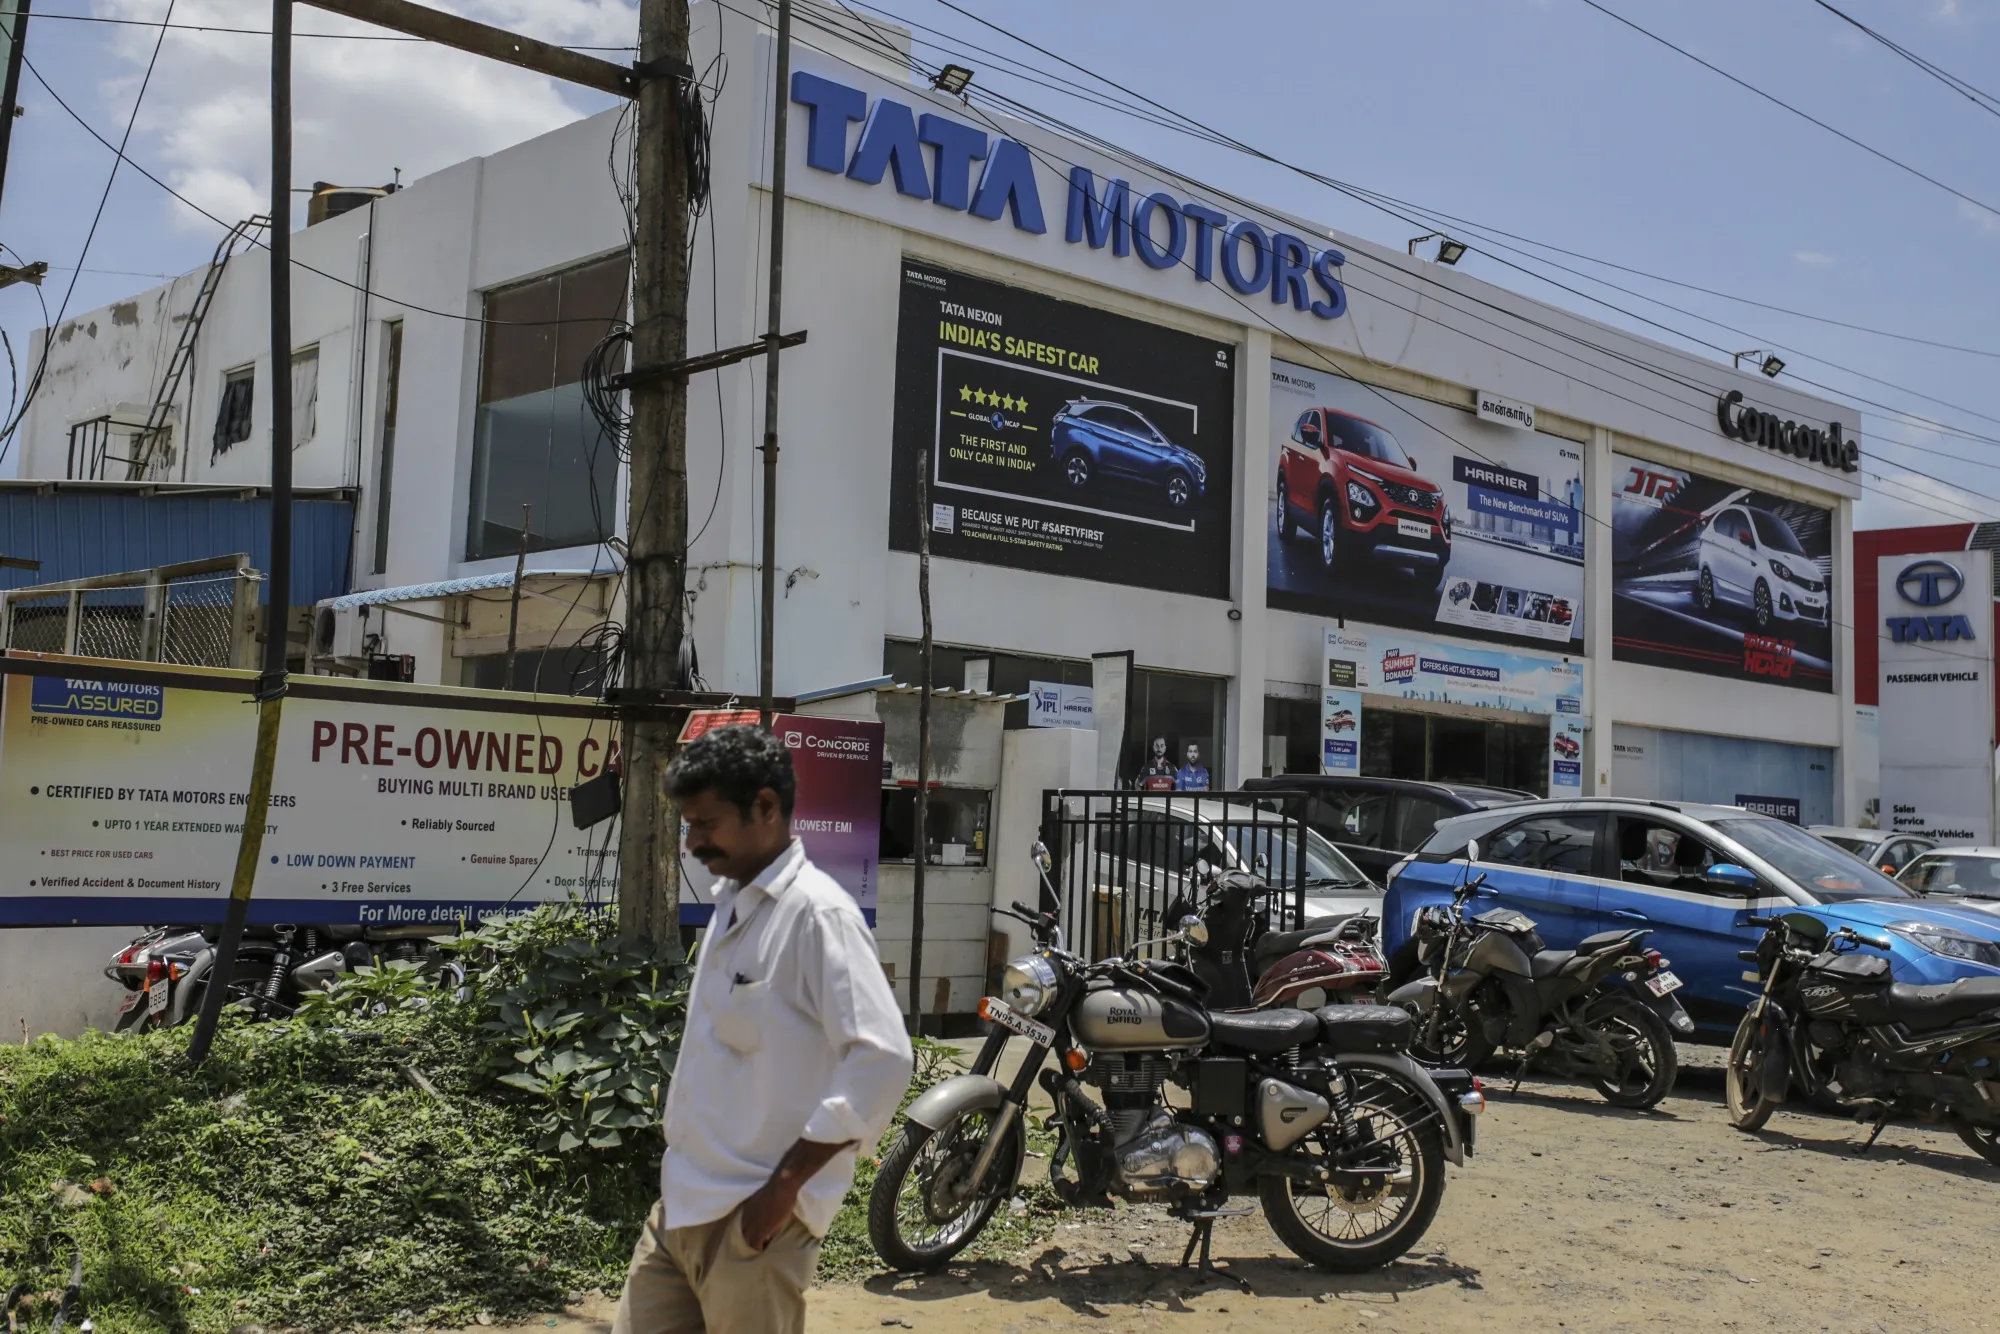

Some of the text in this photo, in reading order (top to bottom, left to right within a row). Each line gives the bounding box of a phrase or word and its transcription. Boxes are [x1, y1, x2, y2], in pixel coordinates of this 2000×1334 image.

[791, 71, 1348, 320] TATA MOTORS
[906, 270, 947, 286] TATA MOTORS
[940, 300, 1002, 326] TATA NEXON
[939, 321, 1099, 375] INDIA'S SAFEST CAR
[1215, 360, 1228, 369] TATA
[1272, 372, 1316, 390] TATA MOTORS
[968, 413, 1020, 428] GLOBAL NCAP
[1718, 390, 1859, 473] Concorde
[960, 433, 1027, 456] THE FIRST AND
[949, 447, 974, 461] ONLY
[975, 452, 994, 465] CAR
[996, 455, 1005, 467] IN
[1566, 451, 1580, 461] TATA
[1465, 465, 1528, 491] HARRIER
[1479, 493, 1569, 524] The New Benchmark of SUVs
[961, 508, 1002, 525] BECAUSE
[1004, 515, 1019, 527] WE
[1021, 518, 1040, 530] PUT
[1041, 521, 1104, 542] #SAFETYFIRST
[1401, 523, 1429, 535] HARRIER
[971, 531, 993, 540] ACHIEVE
[997, 535, 1009, 543] FULL
[1009, 537, 1026, 546] 5-STAR
[1027, 540, 1046, 548] SAFETY
[1045, 542, 1063, 551] RATING
[1885, 614, 1976, 643] TATA
[1387, 650, 1399, 658] MAY
[1384, 657, 1415, 670] SUMMER
[1422, 661, 1442, 671] OFFERS
[1441, 664, 1449, 672] AS
[1448, 665, 1460, 673] HOT
[1466, 667, 1476, 676] THE
[1476, 669, 1498, 679] SUMMER
[1385, 669, 1413, 681] BONANZA
[1886, 671, 1979, 683] PASSENGER VEHICLE
[65, 678, 160, 696] TATA MOTORS
[66, 694, 159, 715] ASSURED
[1042, 700, 1093, 713] IPL HARRIER
[31, 715, 161, 732] PRE-OWNED CARS REASSURED
[311, 720, 563, 775] PRE-OWNED
[805, 735, 870, 752] CONCORDE
[1613, 744, 1644, 754] TATA MOTORS
[816, 751, 838, 759] DRIVEN
[846, 753, 869, 761] SERVICE
[46, 784, 114, 801] CERTIFIED
[118, 788, 135, 802] BY
[138, 789, 169, 803] TATA
[172, 790, 225, 805] MOTORS
[378, 778, 434, 797] BUYING
[438, 780, 484, 798] MULTI
[488, 782, 537, 800] BRAND
[1893, 804, 1916, 813] Sales
[105, 819, 222, 834] UPTO 1 YEAR EXTENDED
[412, 818, 495, 833] Reliably Sourced
[794, 819, 852, 833] LOWEST EMI
[1893, 816, 1924, 825] Service
[1938, 829, 1974, 839] Vehicles
[51, 849, 153, 860] BEST PRICE FOR USED CARS
[286, 854, 416, 870] LOW DOWN PAYMENT
[470, 854, 538, 867] Genuine Spares
[41, 876, 221, 891] Verified Accident & Document History
[331, 881, 412, 894] 3 Free Services
[554, 876, 577, 887] Door
[359, 905, 384, 921] For
[388, 906, 427, 922] More
[431, 906, 473, 923] detail
[1109, 1006, 1138, 1016] ROYAL
[990, 1006, 1048, 1044] TN95.A.3538
[1107, 1015, 1142, 1025] ENFIELD
